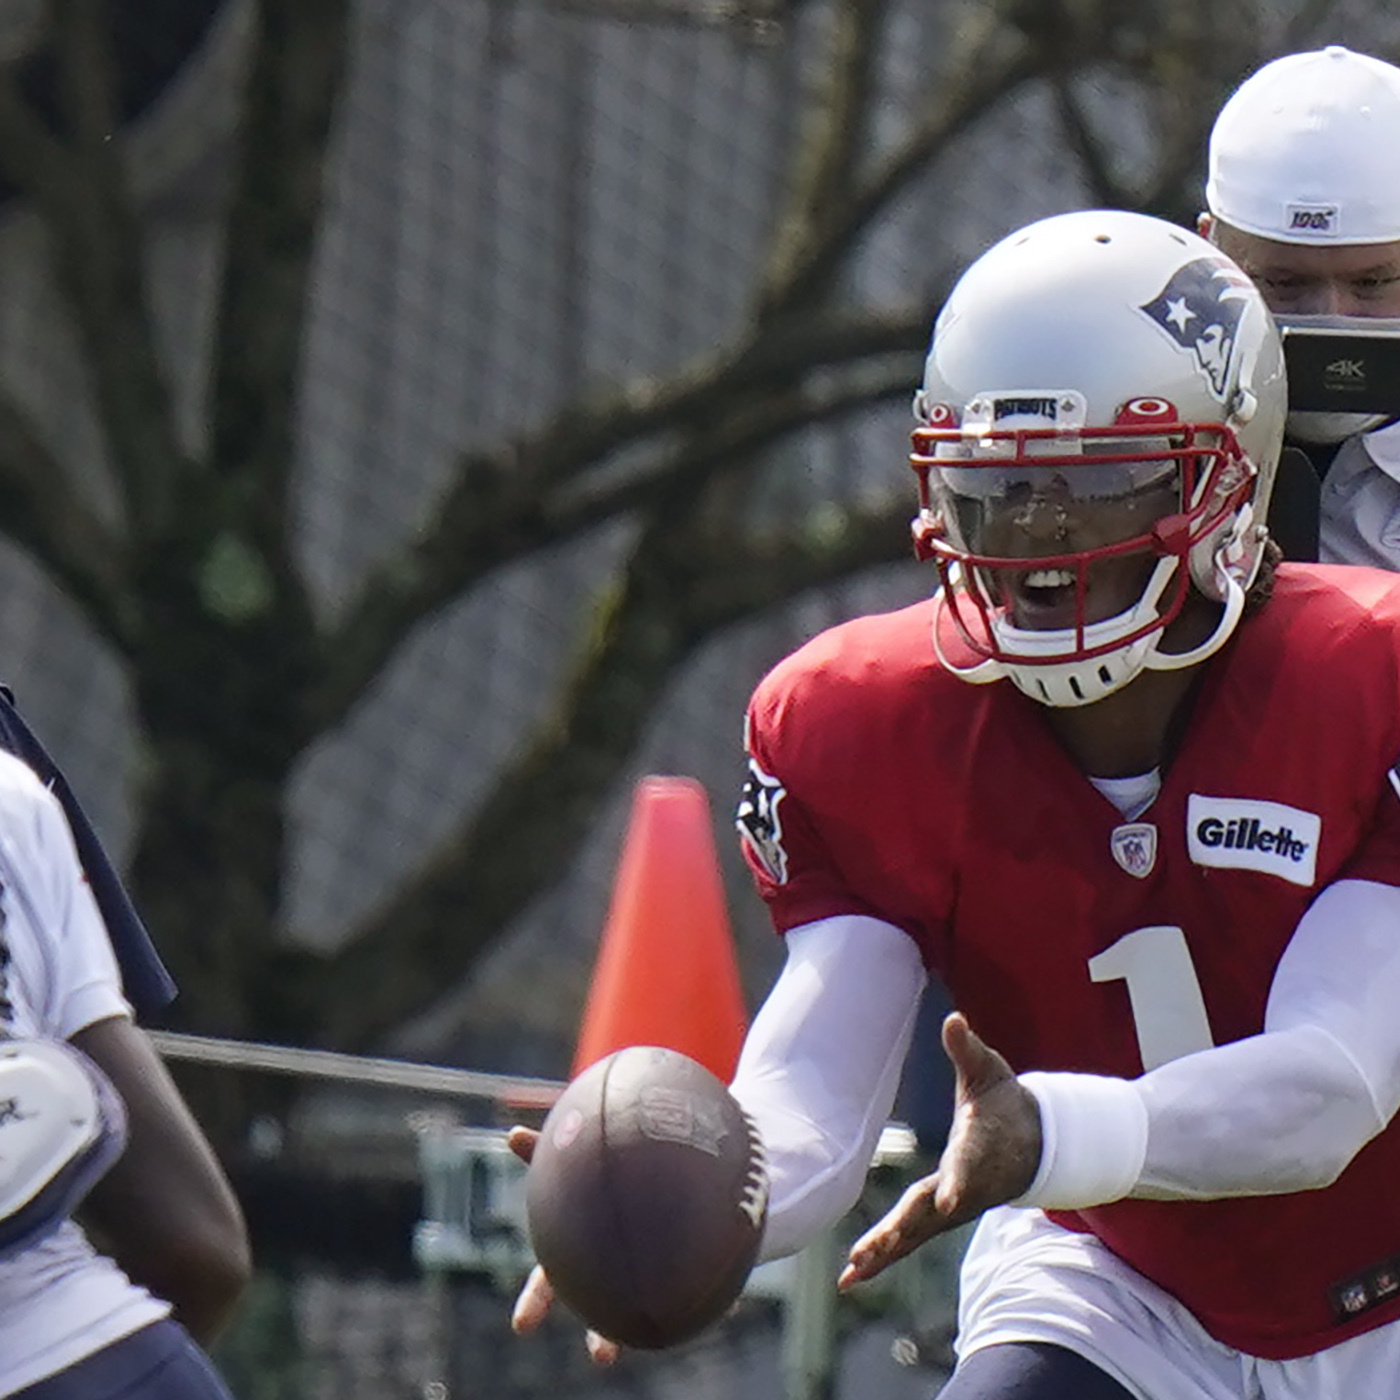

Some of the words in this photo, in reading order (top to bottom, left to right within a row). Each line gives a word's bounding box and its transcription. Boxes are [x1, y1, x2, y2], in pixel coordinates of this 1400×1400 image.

[1325, 360, 1366, 377] 4K
[1197, 817, 1305, 862] Gillette
[1087, 925, 1214, 1073] 1
